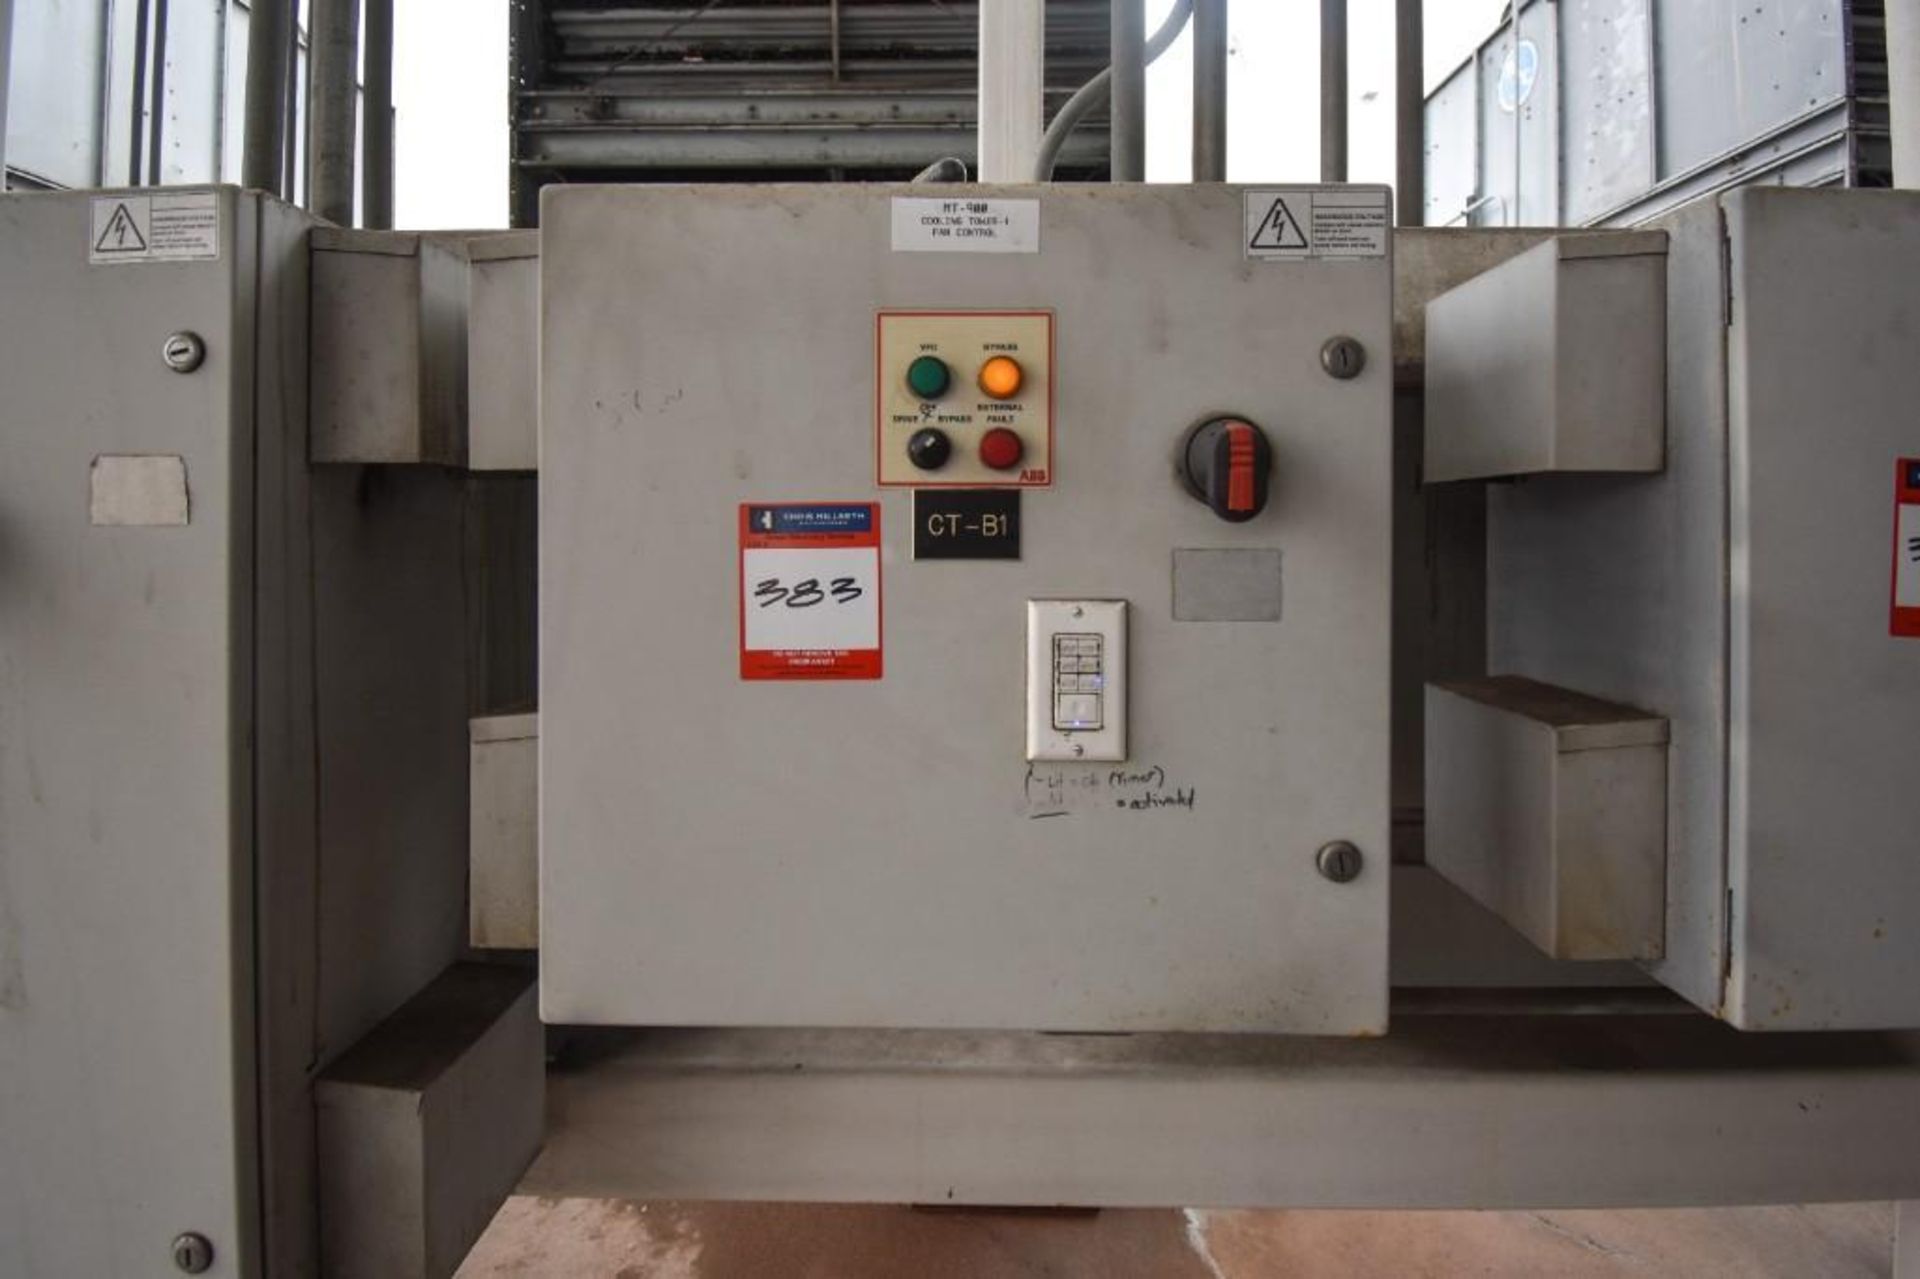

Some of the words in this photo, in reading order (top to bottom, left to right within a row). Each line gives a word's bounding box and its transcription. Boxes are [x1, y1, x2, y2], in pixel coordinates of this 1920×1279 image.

[1019, 470, 1046, 482] ABB
[928, 513, 1007, 536] CT-B1
[754, 578, 863, 608] 383
